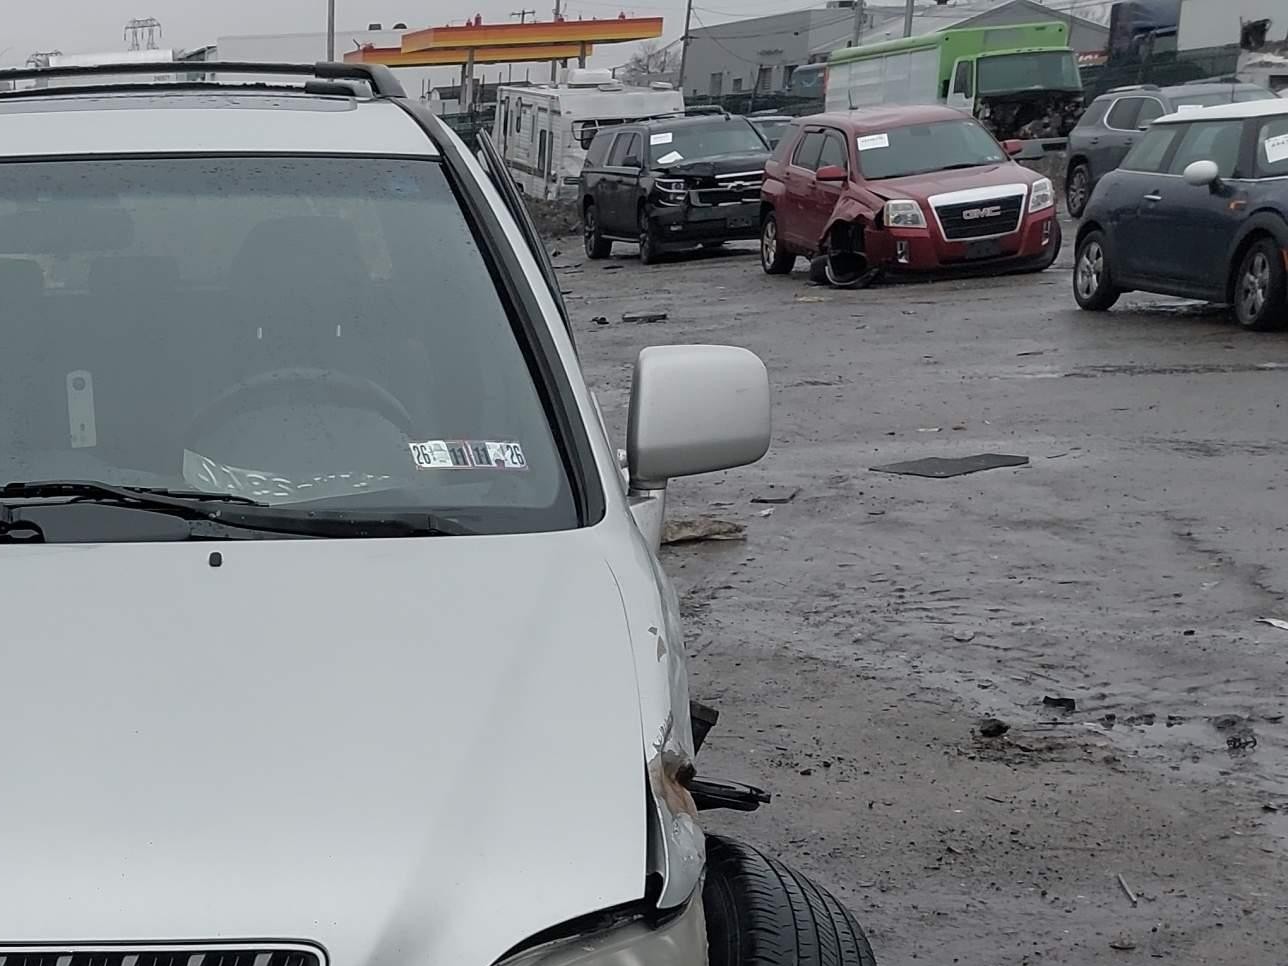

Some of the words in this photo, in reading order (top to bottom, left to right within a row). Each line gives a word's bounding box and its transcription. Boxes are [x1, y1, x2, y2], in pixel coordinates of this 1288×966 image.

[963, 206, 1000, 219] GMC
[413, 445, 431, 465] 26
[450, 447, 469, 465] 11
[474, 446, 492, 465] 11
[507, 445, 525, 465] 26
